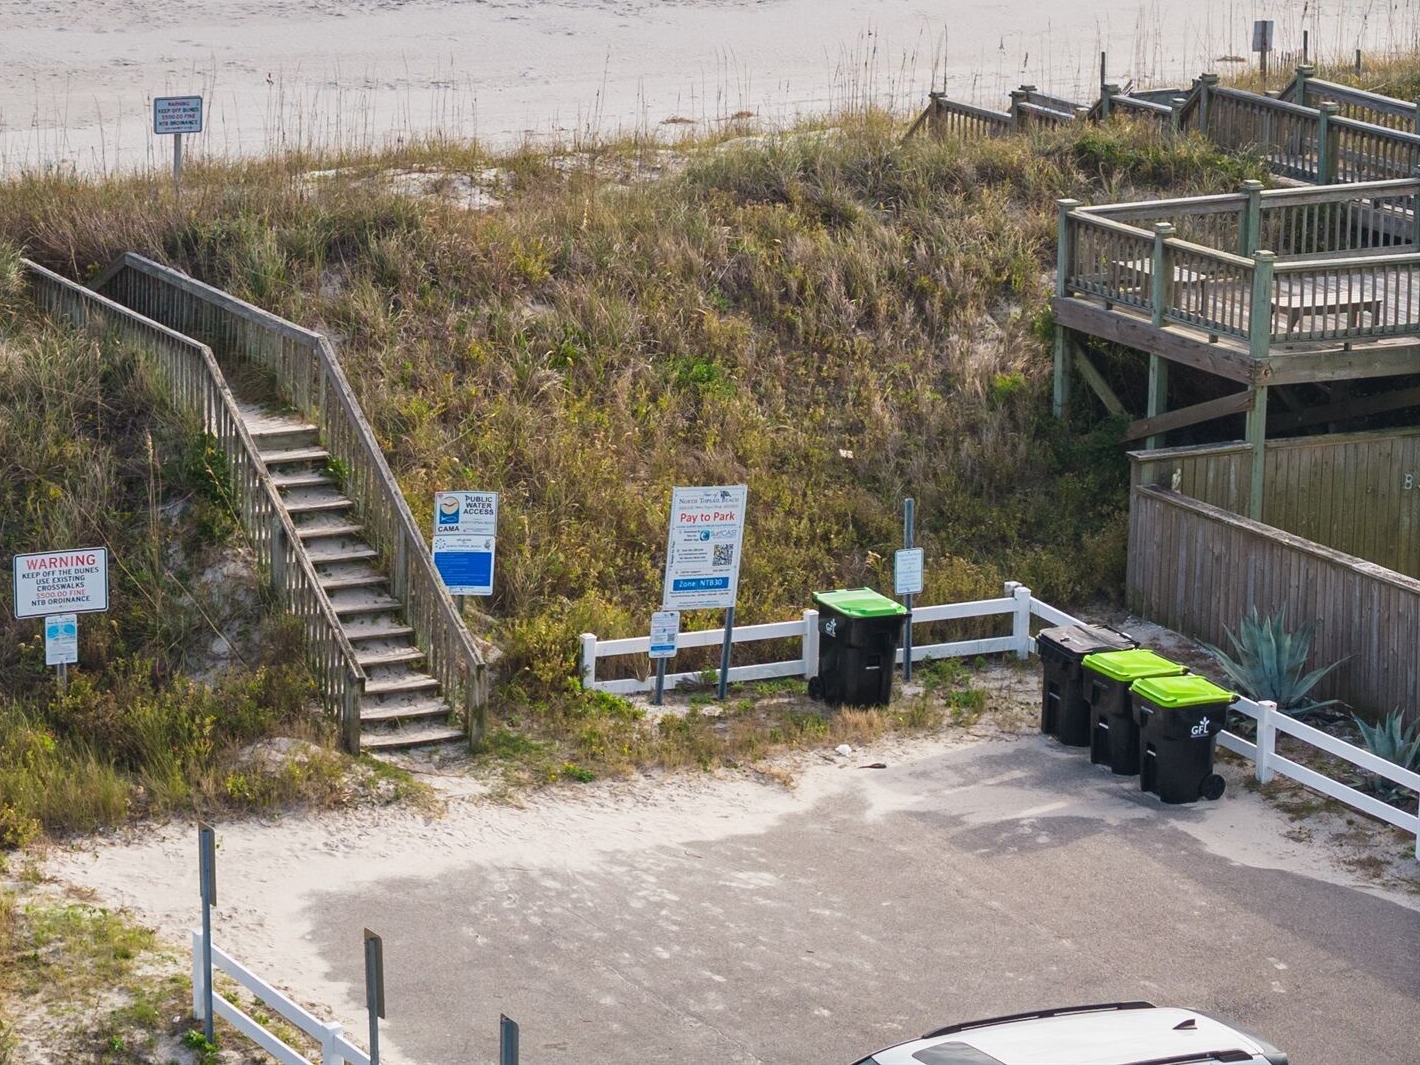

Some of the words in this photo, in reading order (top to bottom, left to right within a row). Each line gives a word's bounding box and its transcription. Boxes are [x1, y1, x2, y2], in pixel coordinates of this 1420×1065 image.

[465, 495, 493, 503] PUBLIC
[680, 512, 698, 523] Pay
[700, 513, 711, 522] to
[713, 511, 735, 521] Park
[27, 554, 96, 570] WARNING
[22, 571, 40, 579] KEEP
[42, 570, 56, 578] OFF
[58, 568, 72, 576] THE
[74, 566, 99, 574] DUNES
[36, 577, 50, 585] USE
[52, 575, 85, 584] EXISTING
[700, 578, 723, 587] NTB30
[36, 581, 85, 592] CROSSWALKS
[36, 591, 68, 599] $500.00
[47, 596, 90, 605] ORDINANCE
[1191, 719, 1209, 734] GFL
